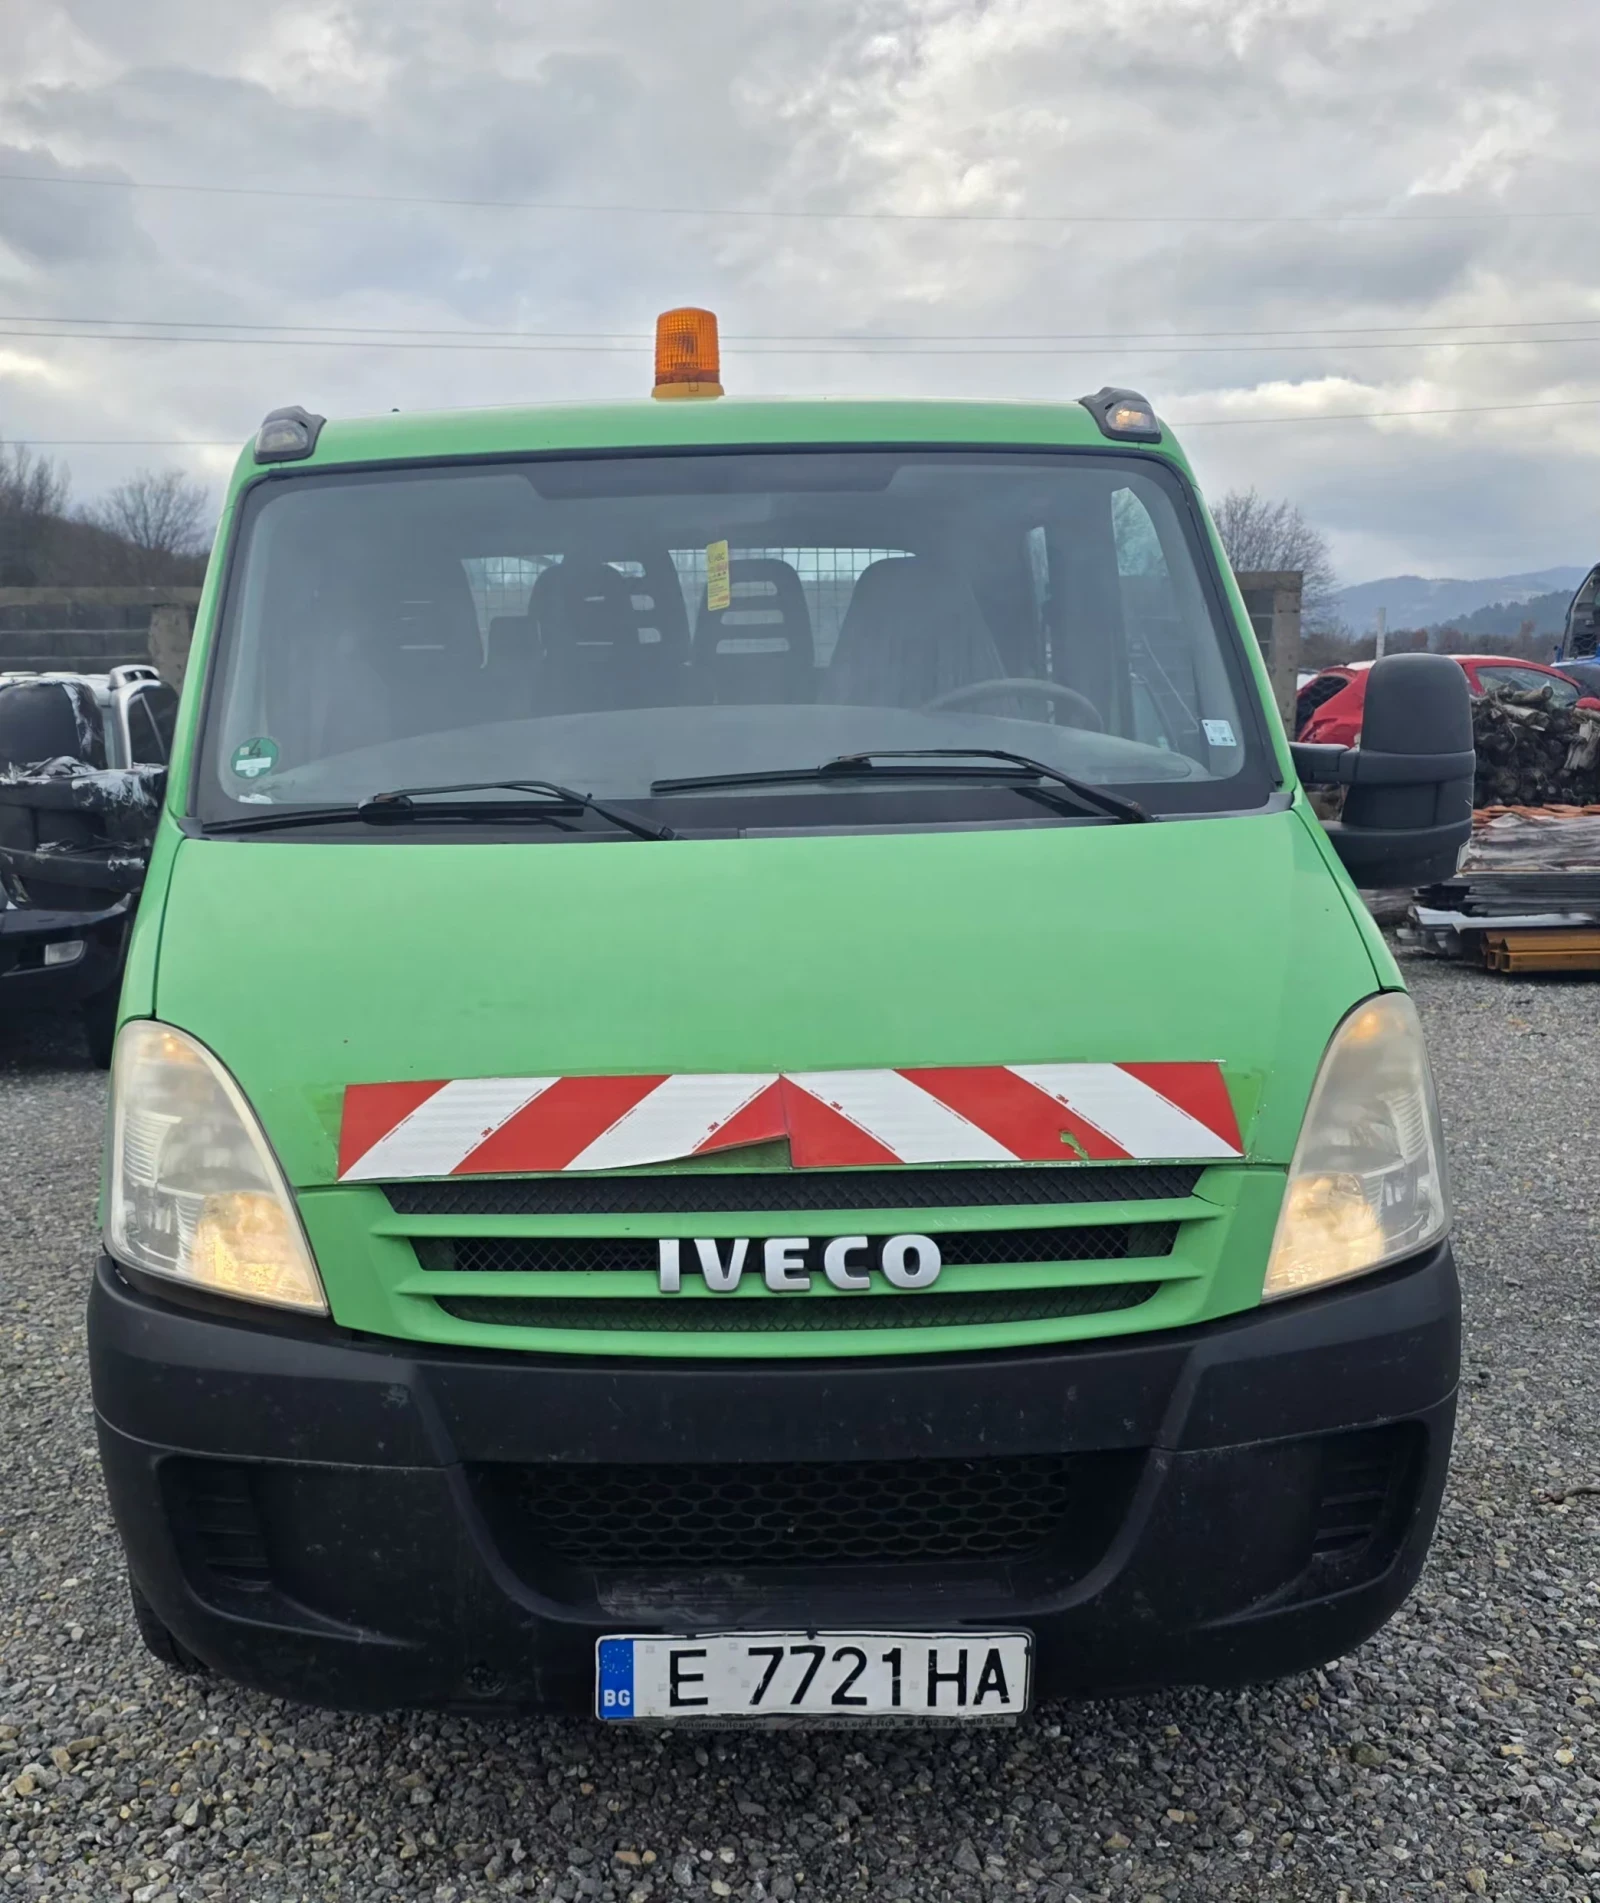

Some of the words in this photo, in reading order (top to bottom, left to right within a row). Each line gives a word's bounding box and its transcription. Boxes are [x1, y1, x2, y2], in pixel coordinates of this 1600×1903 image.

[249, 739, 262, 758] 4
[830, 1101, 843, 1111] 3M
[1056, 1093, 1069, 1105] 3M
[480, 1126, 494, 1138] 3M
[707, 1121, 720, 1133] 3M
[658, 1233, 942, 1293] IVECO
[668, 1649, 709, 1707] E
[747, 1645, 902, 1707] 7721
[927, 1648, 1011, 1707] HA
[603, 1689, 631, 1707] BG
